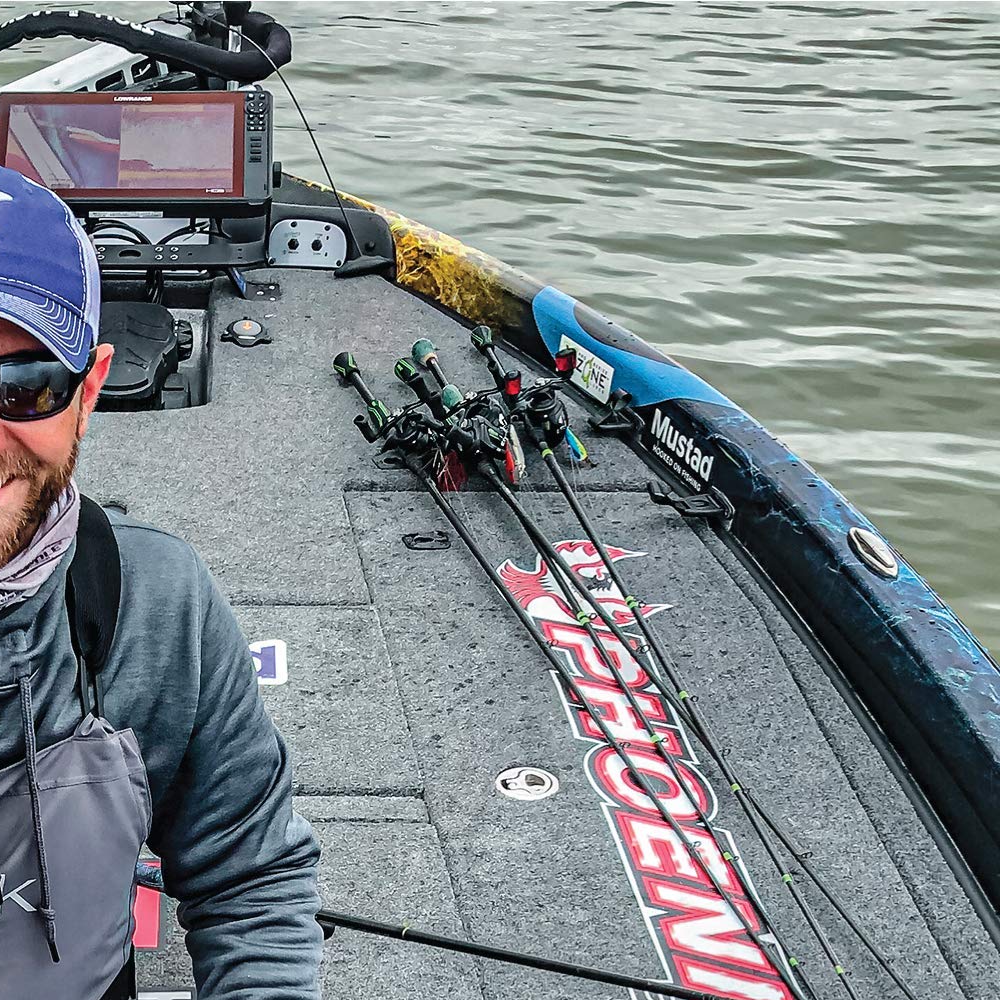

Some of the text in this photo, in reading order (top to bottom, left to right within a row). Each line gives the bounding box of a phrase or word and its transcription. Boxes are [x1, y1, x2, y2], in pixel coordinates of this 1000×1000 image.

[651, 408, 714, 482] Mustad
[652, 441, 702, 492] HOOKED ON FISHING
